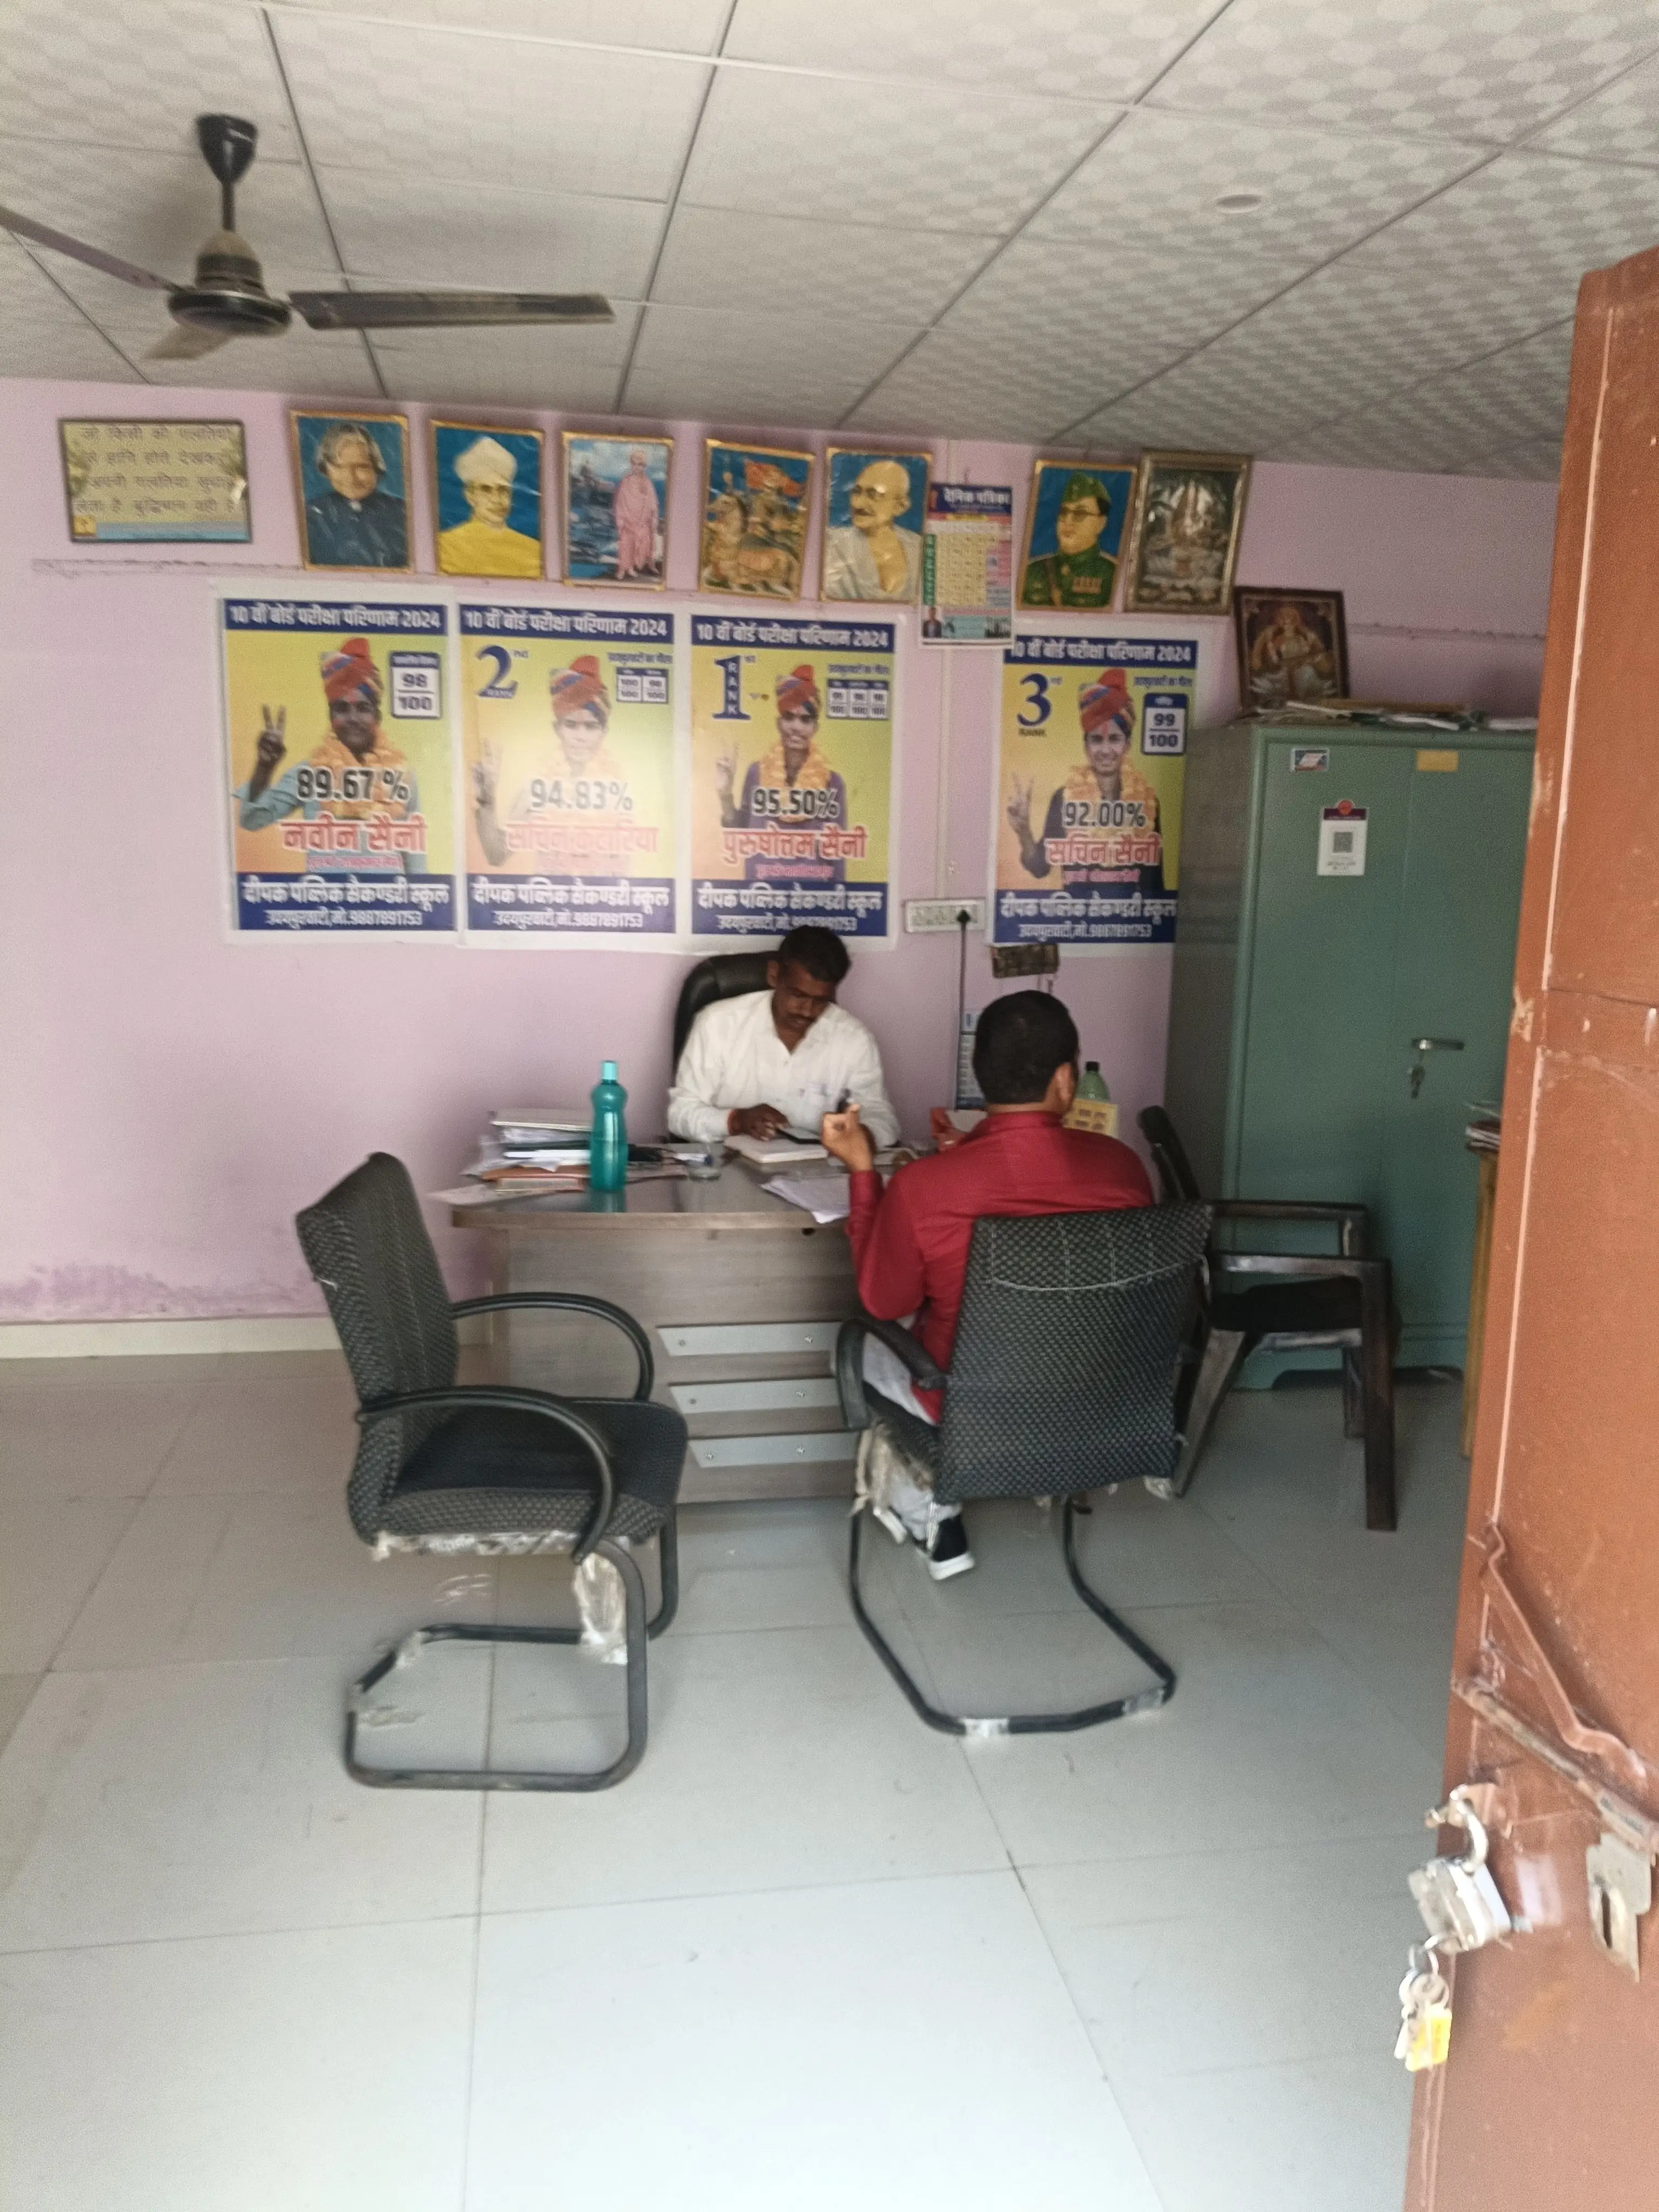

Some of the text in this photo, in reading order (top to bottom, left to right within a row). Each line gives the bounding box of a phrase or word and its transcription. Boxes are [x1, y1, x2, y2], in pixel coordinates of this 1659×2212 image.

[230, 604, 247, 624] 10
[298, 604, 341, 626] परीक्षा
[342, 605, 400, 628] परिणाम
[401, 610, 441, 629] 2024
[464, 609, 483, 629] 10
[529, 610, 571, 632] परीक्षा
[573, 612, 626, 635] परिणाम
[629, 619, 667, 637] 2024
[696, 623, 713, 641] 10
[852, 630, 889, 648] 2024
[397, 696, 433, 711] 100
[1152, 713, 1175, 726] 99
[1149, 734, 1178, 748] 100
[297, 768, 375, 800] 89.67
[531, 779, 633, 811] 94.83%
[753, 788, 840, 818] 95.50%
[1065, 801, 1147, 827] 92.00%
[279, 812, 427, 853] नवीन सैनी
[820, 824, 867, 859] सैनी
[1046, 831, 1161, 864] सचिन सैनी
[241, 874, 289, 904] दीपक
[290, 874, 344, 905] पब्लिक
[409, 884, 450, 912] स्कूल
[471, 876, 516, 905] दीपक
[517, 876, 569, 905] पब्लिक
[632, 886, 670, 915] स्कूल
[697, 882, 738, 909] दीपक
[847, 890, 882, 918] स्कूल
[1000, 892, 1038, 918] दीपक
[1143, 899, 1177, 925] स्कूल
